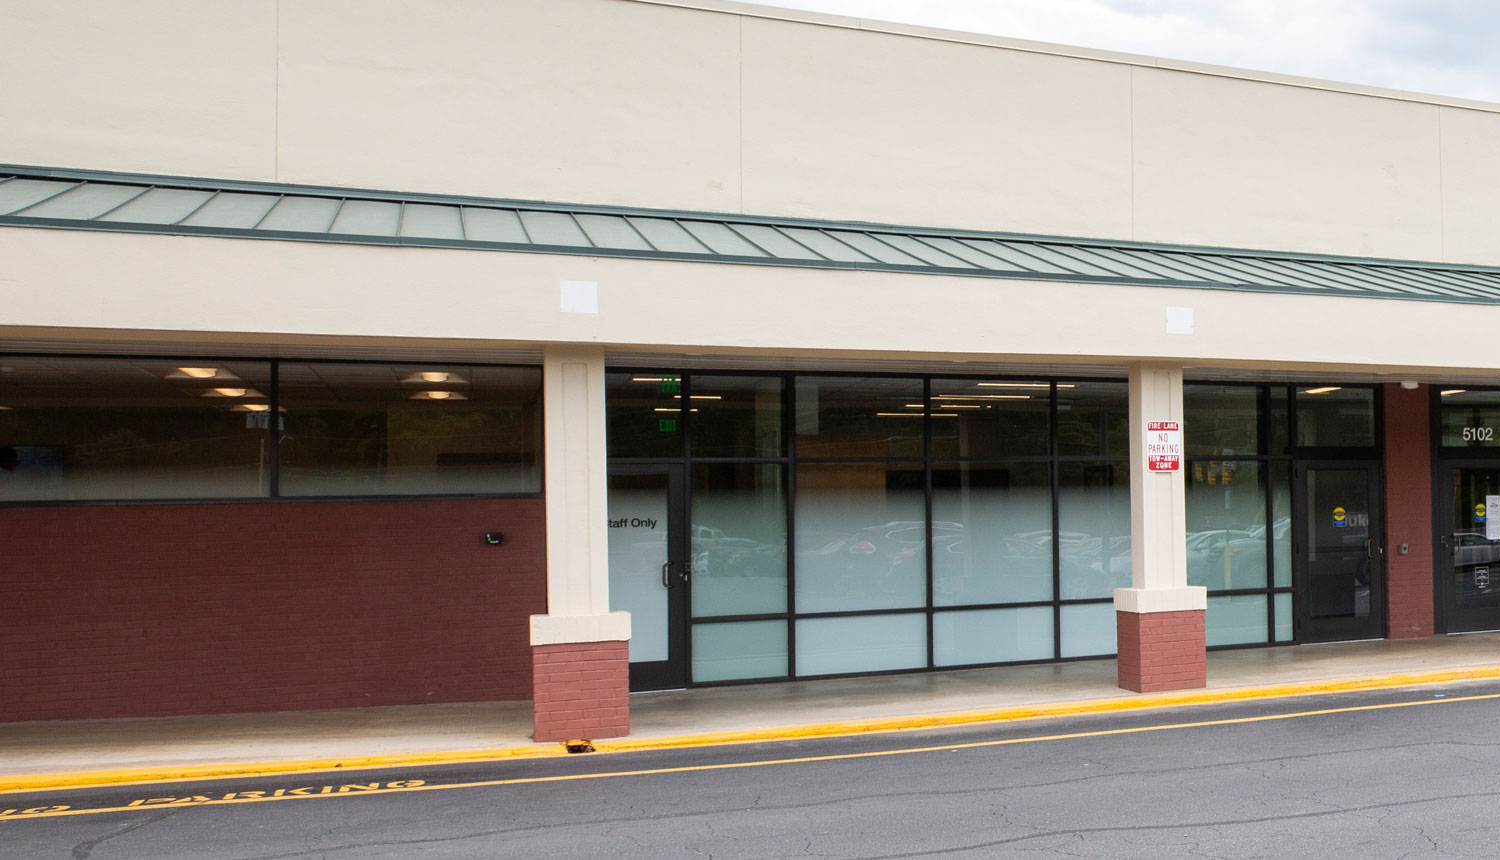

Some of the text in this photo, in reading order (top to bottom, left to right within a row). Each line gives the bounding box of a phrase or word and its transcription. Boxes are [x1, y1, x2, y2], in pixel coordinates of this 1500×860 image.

[659, 418, 677, 432] EXIT
[1158, 433, 1169, 442] NO
[1462, 427, 1493, 441] 5102
[1148, 444, 1179, 454] PARKING
[608, 517, 657, 530] taff Only
